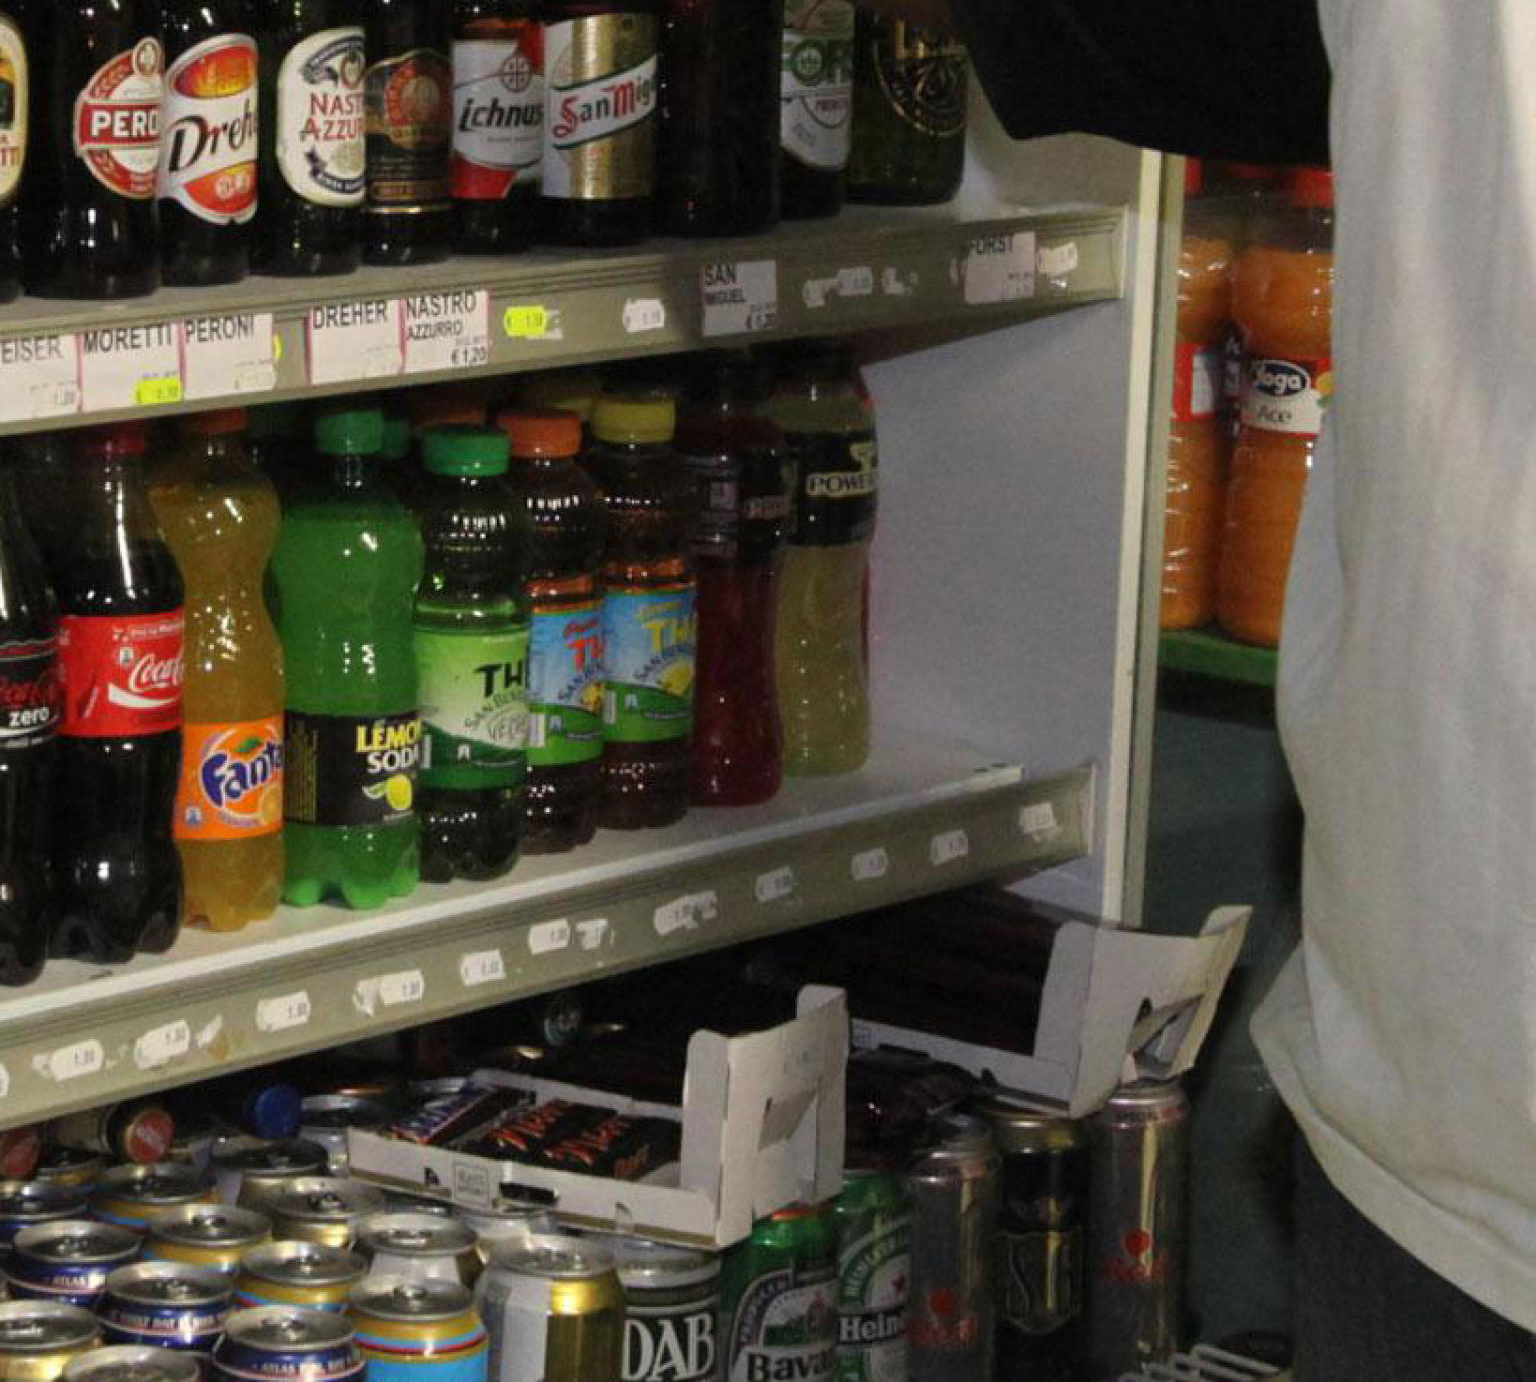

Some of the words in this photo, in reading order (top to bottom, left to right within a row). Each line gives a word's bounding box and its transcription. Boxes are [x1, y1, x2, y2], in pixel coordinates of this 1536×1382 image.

[704, 263, 738, 286] SAN
[312, 299, 388, 330] DREHER
[405, 290, 477, 318] NASTRO
[83, 323, 174, 355] MORETTI
[185, 317, 256, 343] PERONI
[8, 705, 50, 727] zero
[622, 1310, 717, 1382] DAB
